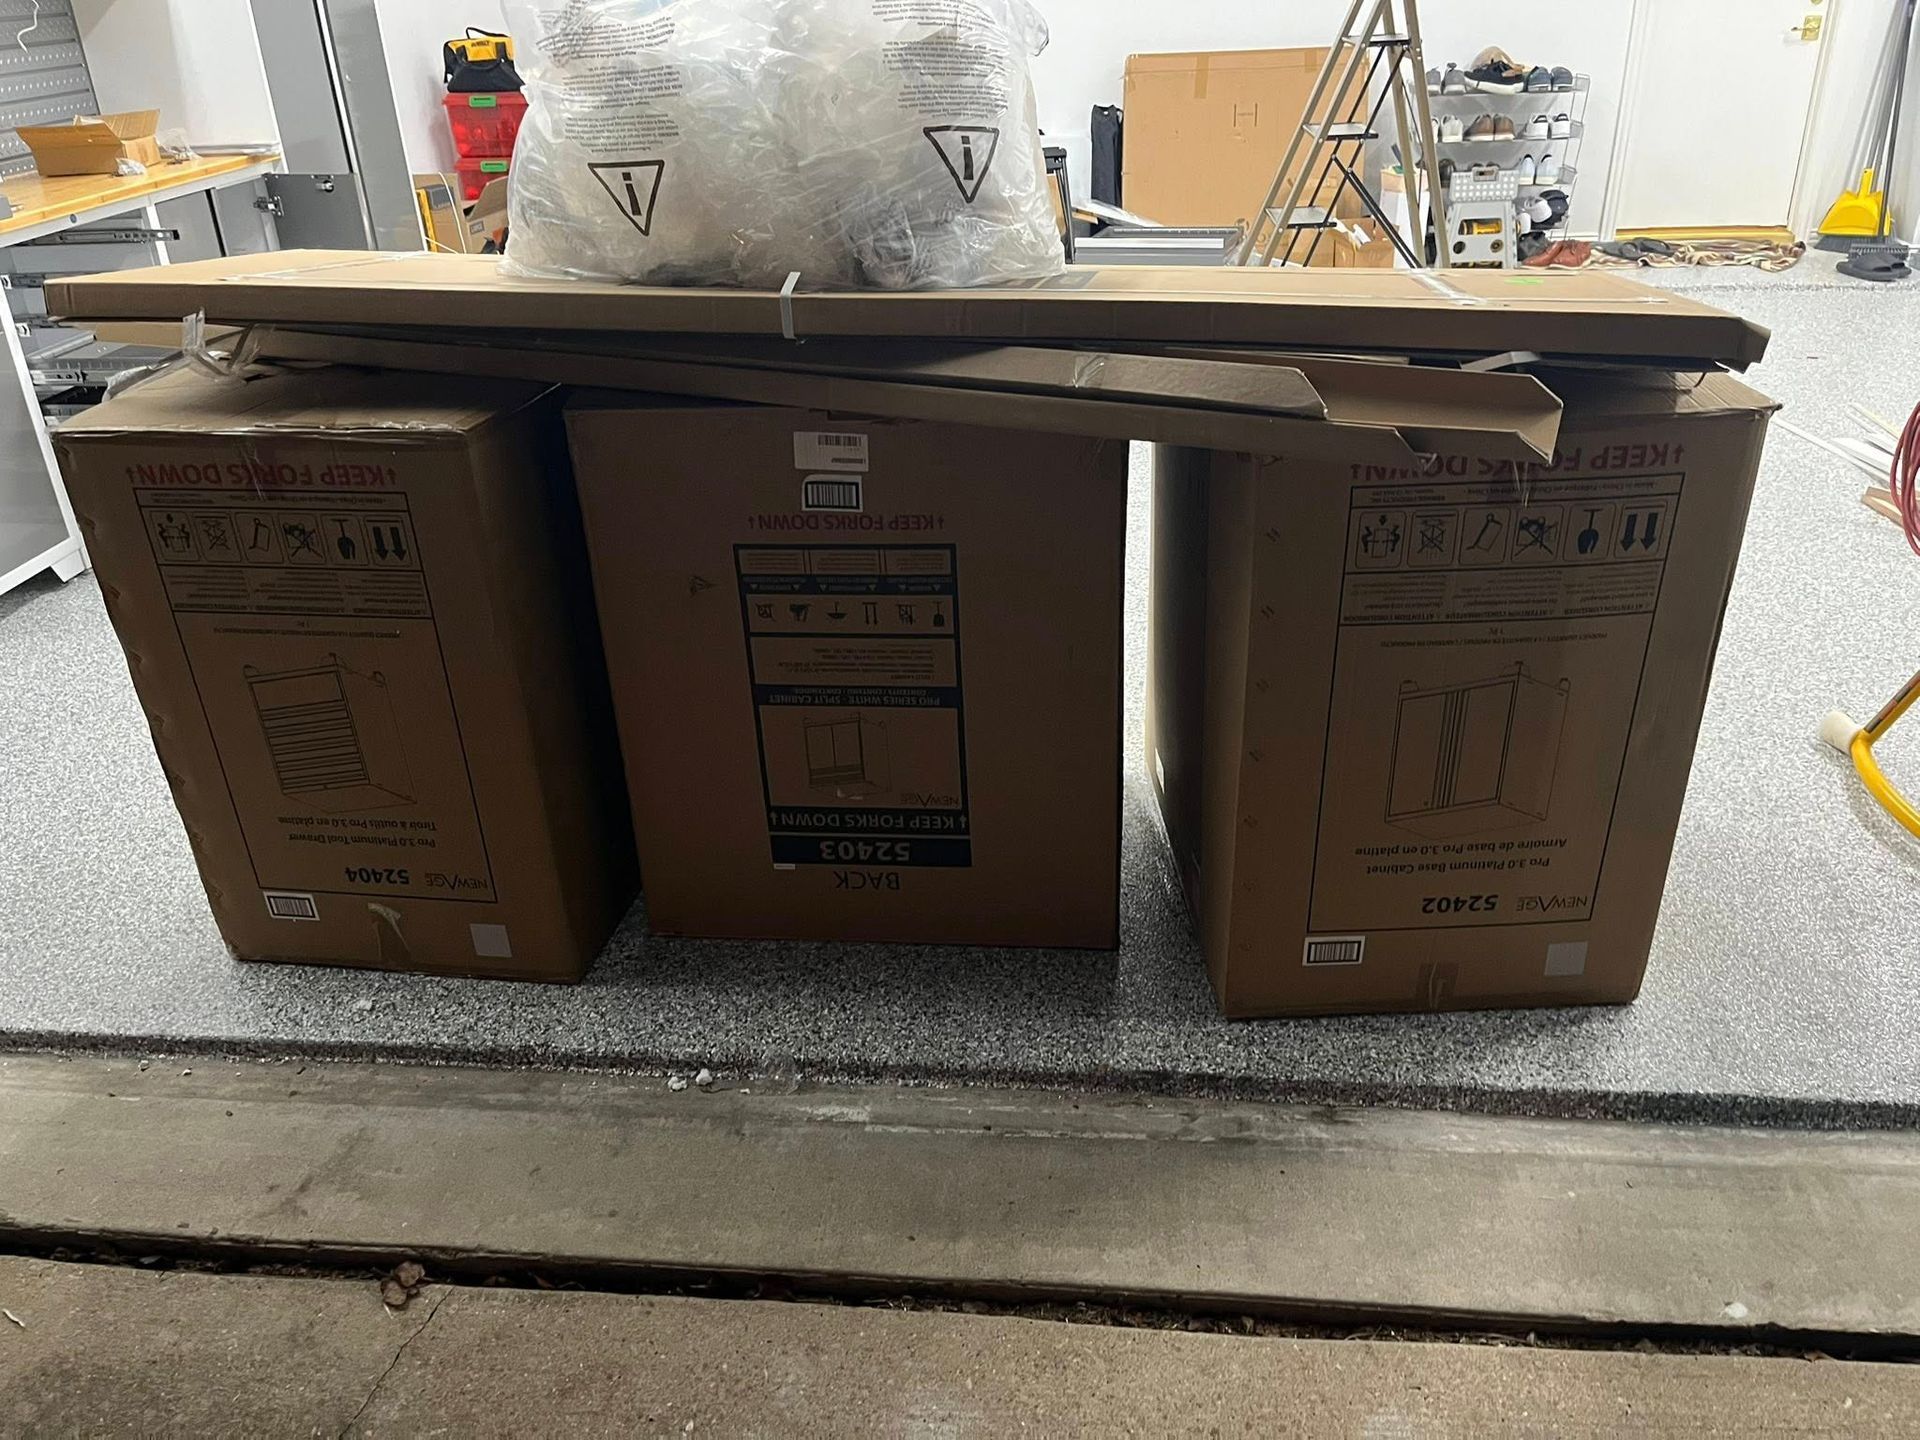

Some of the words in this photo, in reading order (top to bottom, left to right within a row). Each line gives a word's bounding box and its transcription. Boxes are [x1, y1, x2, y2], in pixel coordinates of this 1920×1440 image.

[1590, 442, 1669, 472] KEEP
[136, 464, 222, 486] DOWN
[227, 463, 314, 488] FORKS
[320, 465, 384, 488] KEEP
[758, 514, 819, 530] DOWN
[823, 514, 884, 530] FORKS
[888, 515, 934, 530] KEEP
[769, 694, 811, 703] CABINET
[814, 695, 841, 703] SPLIT
[849, 695, 881, 704] WHITE
[883, 696, 915, 705] SERIES
[919, 696, 940, 706] PRO
[899, 792, 959, 808] NEWAGE
[277, 815, 314, 827] platine
[318, 818, 330, 826] en
[332, 818, 347, 827] 3.0
[349, 818, 367, 828] Pro
[369, 818, 398, 829] outils
[409, 821, 436, 831] Tiroir
[782, 813, 839, 827] DOWN
[845, 814, 904, 828] FORKS
[909, 815, 954, 829] KEEP
[288, 833, 325, 844] Drawer
[327, 834, 350, 845] Tool
[351, 835, 398, 847] Platinum
[399, 836, 415, 847] 3.0
[417, 838, 436, 849] Pro
[1517, 837, 1567, 851] Armoire
[820, 841, 910, 861] 52403
[1354, 844, 1400, 858] platine
[1402, 845, 1418, 855] en
[1420, 845, 1440, 856] 3.0
[1443, 843, 1464, 855] Pro
[1466, 841, 1496, 853] base
[1498, 841, 1514, 852] de
[1418, 862, 1447, 873] Base
[1449, 859, 1505, 872] Platinum
[1507, 859, 1526, 870] 3.0
[1529, 857, 1550, 868] Pro
[1366, 863, 1414, 875] Cabinet
[344, 867, 410, 885] 52404
[424, 873, 488, 890] NEWAGE
[832, 870, 900, 890] BACK
[1421, 894, 1500, 914] 52402
[1516, 894, 1588, 913] NEWAGE
